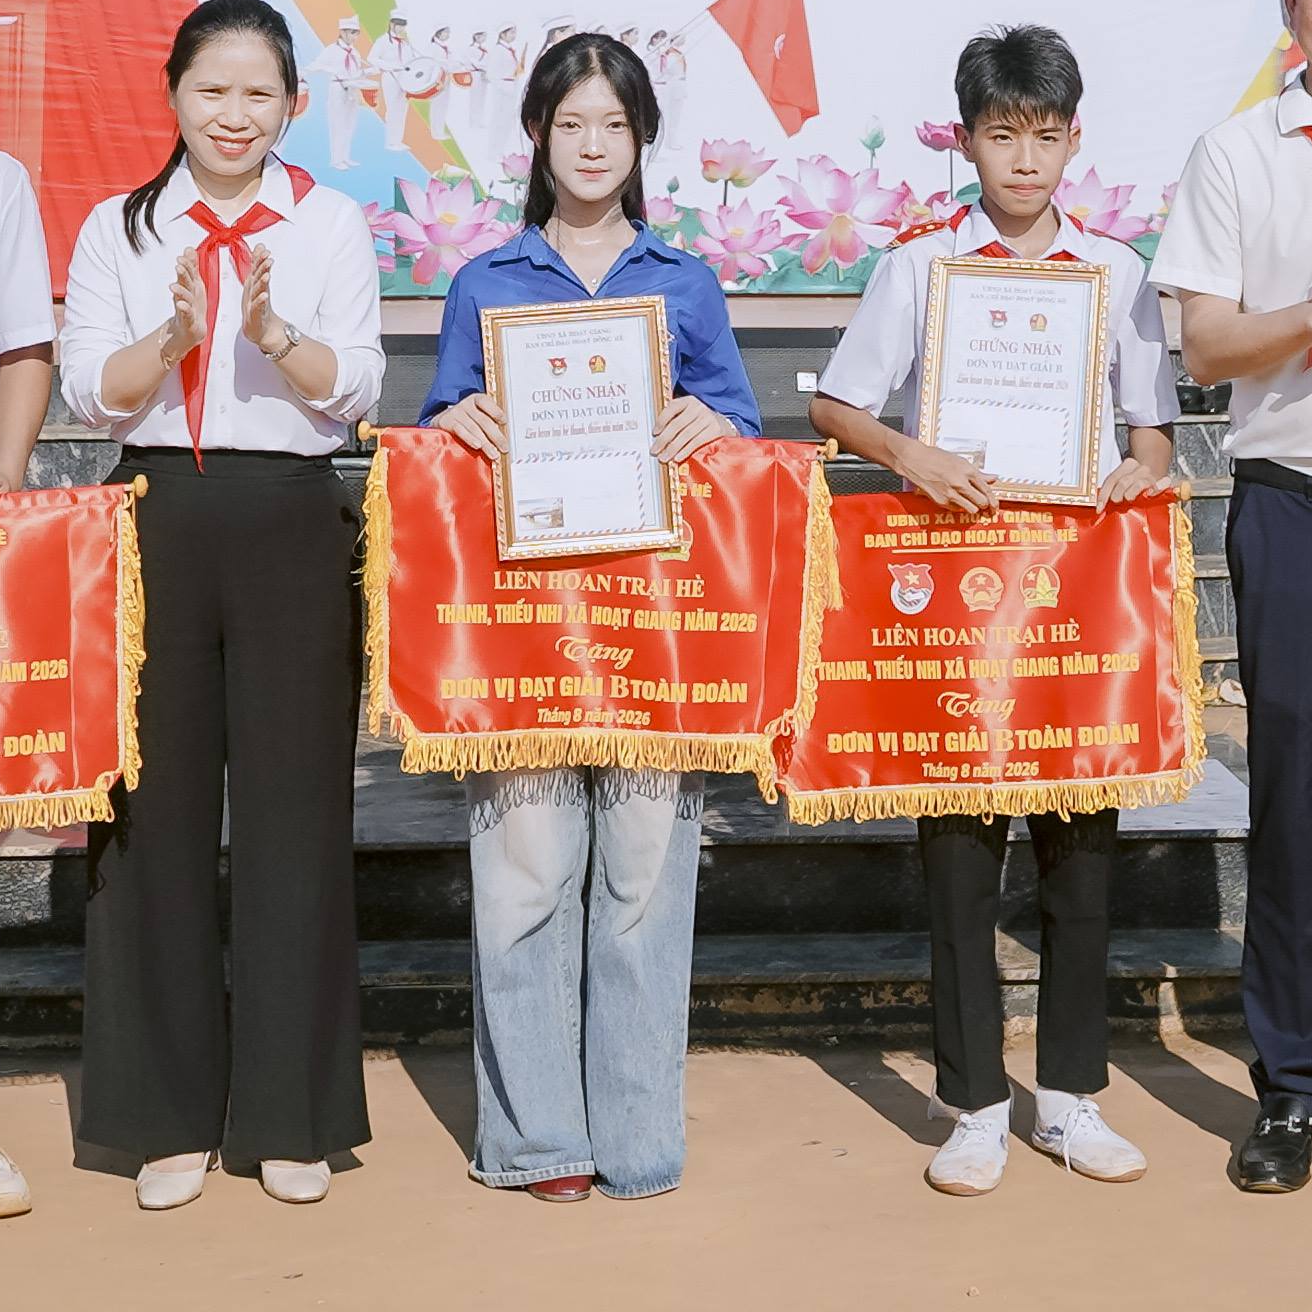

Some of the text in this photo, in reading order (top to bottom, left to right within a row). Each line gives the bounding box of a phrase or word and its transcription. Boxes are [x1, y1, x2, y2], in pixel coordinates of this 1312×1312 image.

[494, 567, 705, 601] LIÊN HOAN TRẠI HÈ
[871, 623, 919, 648] LIÊN
[923, 627, 985, 647] HOAN
[1050, 618, 1080, 643] HÈ
[555, 635, 634, 670] Tặng
[440, 671, 748, 704] ĐƠN VỊ ĐẠT GIẢI B TOÀN ĐOÀN
[937, 691, 1016, 721] Tặng
[3, 729, 66, 757] ĐOÀN
[827, 722, 1139, 757] ĐƠN VỊ ĐẠT GIẢI B TOÀN ĐOÀN
